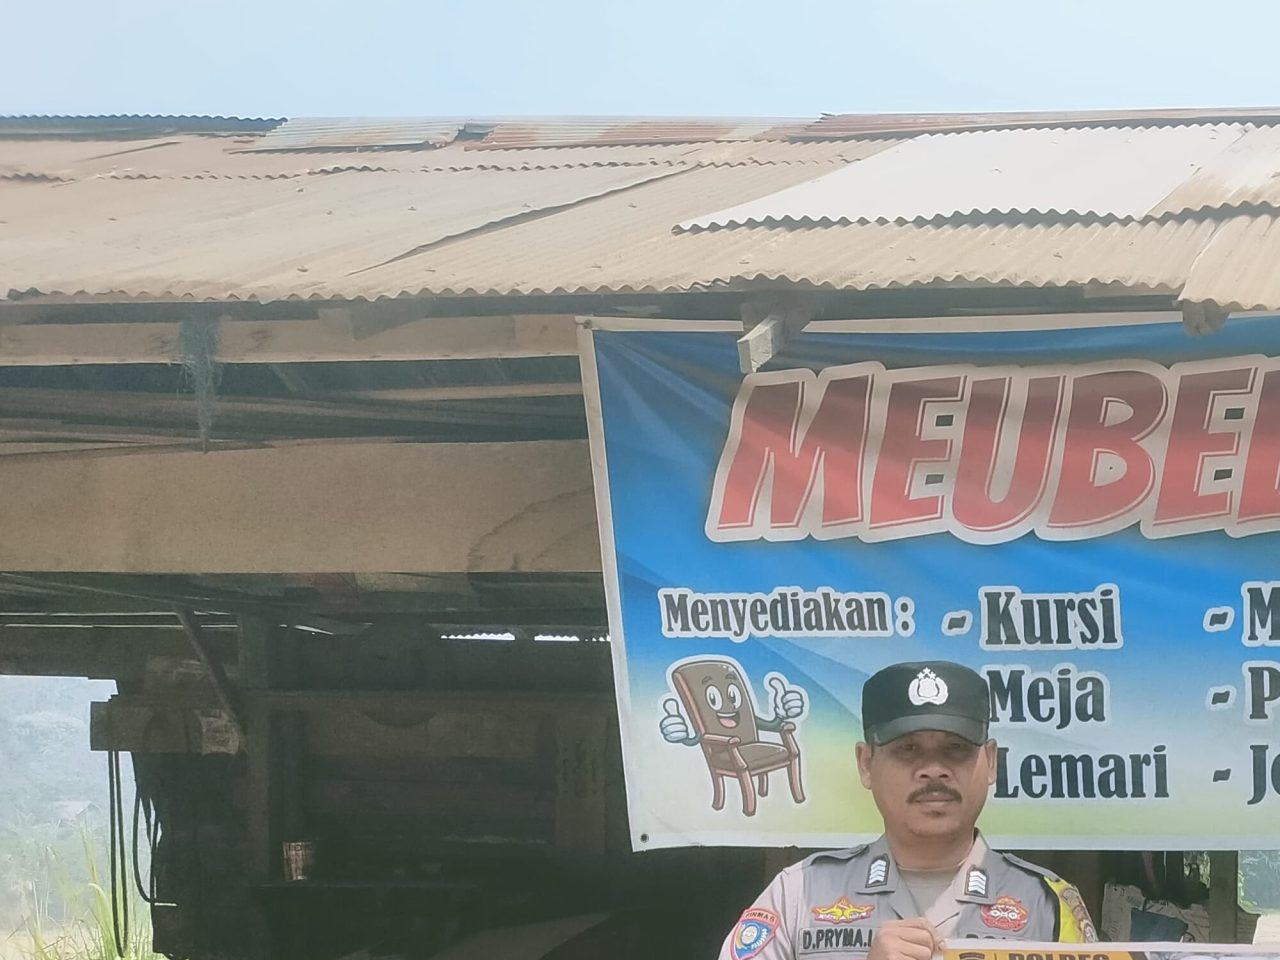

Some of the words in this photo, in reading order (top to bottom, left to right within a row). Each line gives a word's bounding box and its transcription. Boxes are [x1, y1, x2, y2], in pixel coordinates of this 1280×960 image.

[984, 588, 1119, 646] Kursi
[988, 669, 1106, 729] Meja
[995, 744, 1170, 800] Lemari
